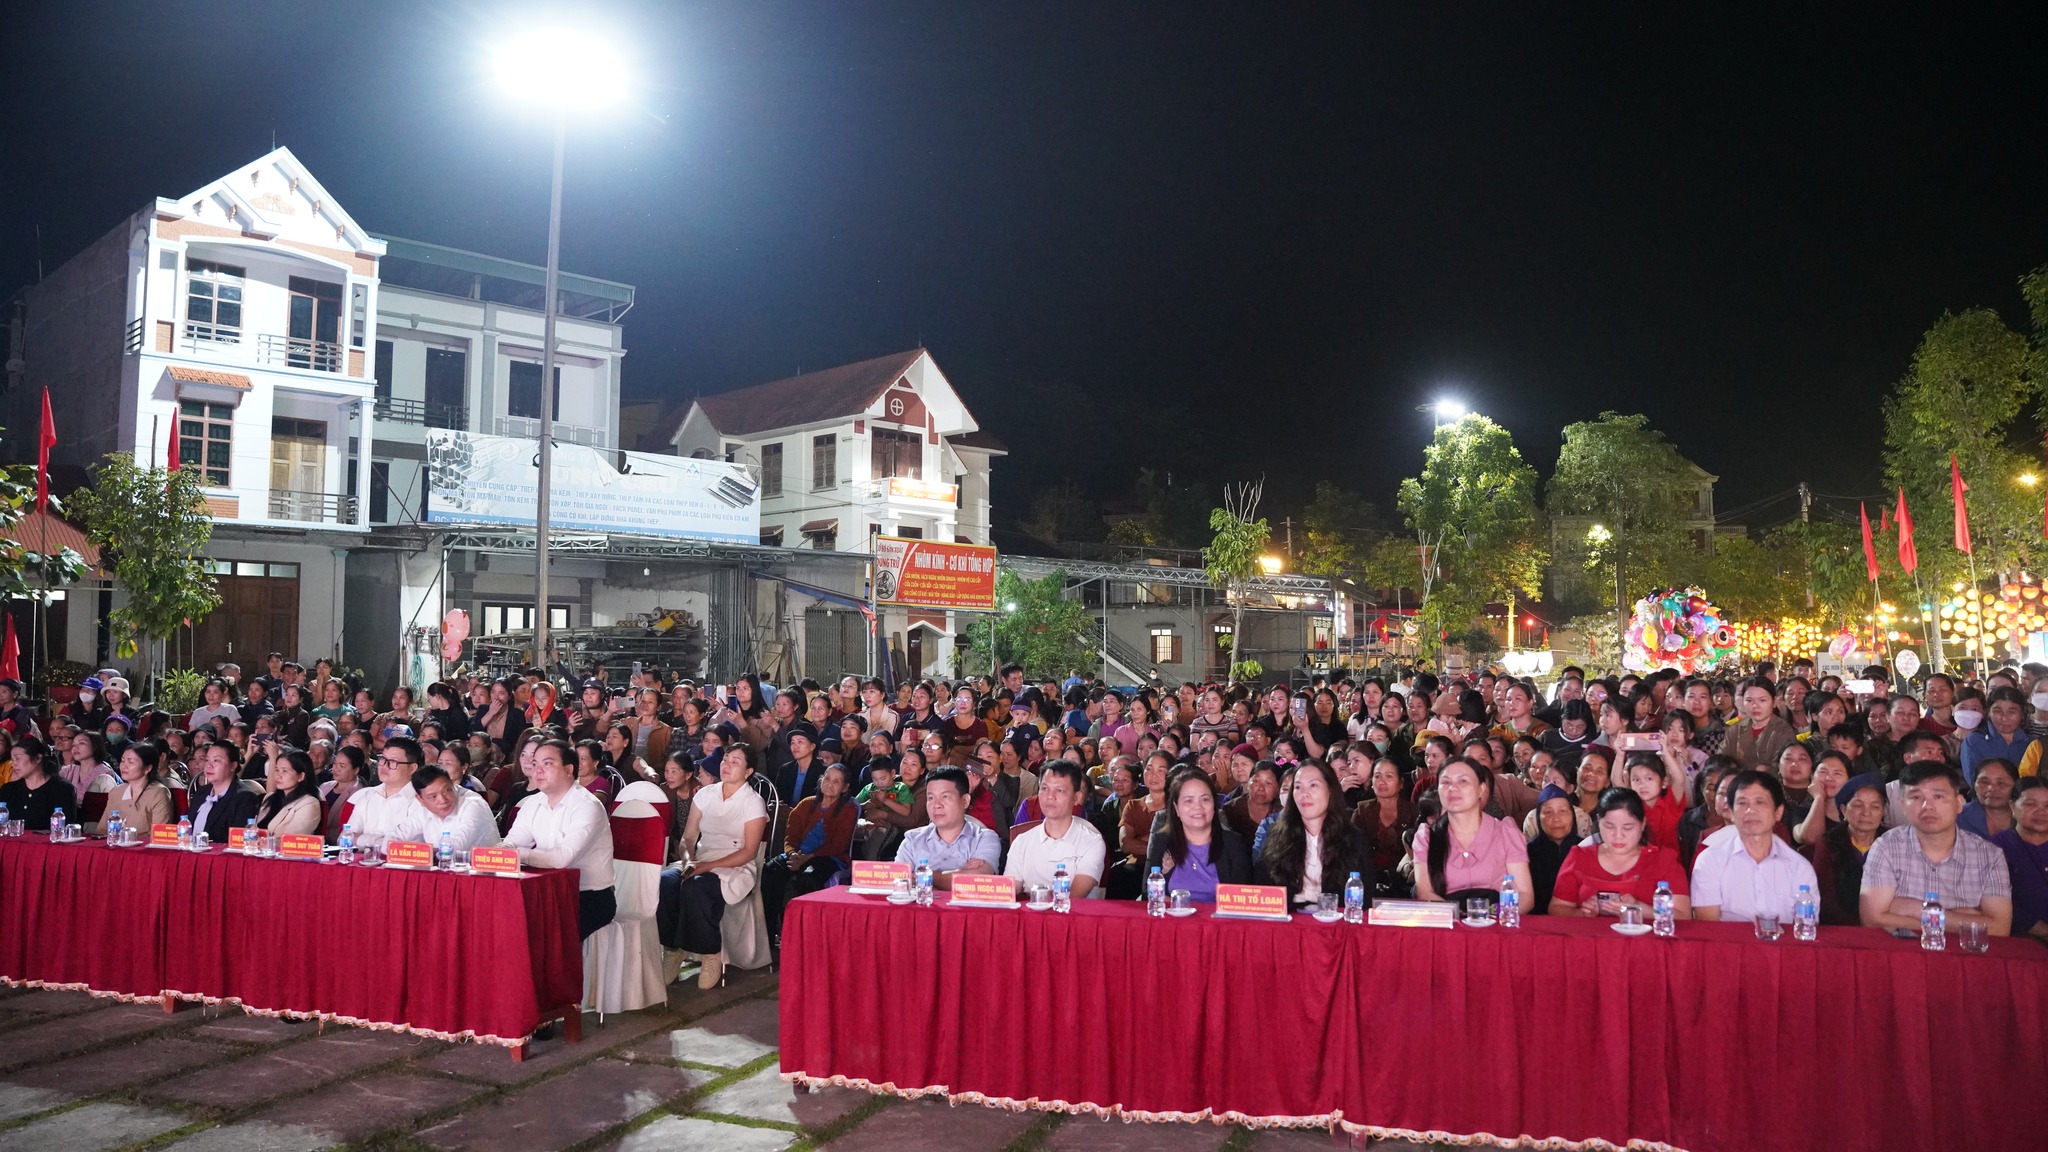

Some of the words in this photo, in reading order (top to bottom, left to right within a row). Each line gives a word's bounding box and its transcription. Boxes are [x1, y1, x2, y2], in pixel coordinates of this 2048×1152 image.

[915, 549, 931, 568] NHÔM
[932, 550, 945, 570] KÍNH
[949, 554, 957, 571] CƠ
[957, 553, 967, 571] KHÍ
[968, 551, 982, 573] TỔNG
[982, 557, 993, 576] HỢP
[1219, 893, 1231, 902] HÀ
[1232, 894, 1246, 905] THỊ
[1248, 893, 1259, 904] TỐ
[1260, 896, 1283, 905] LOAN
